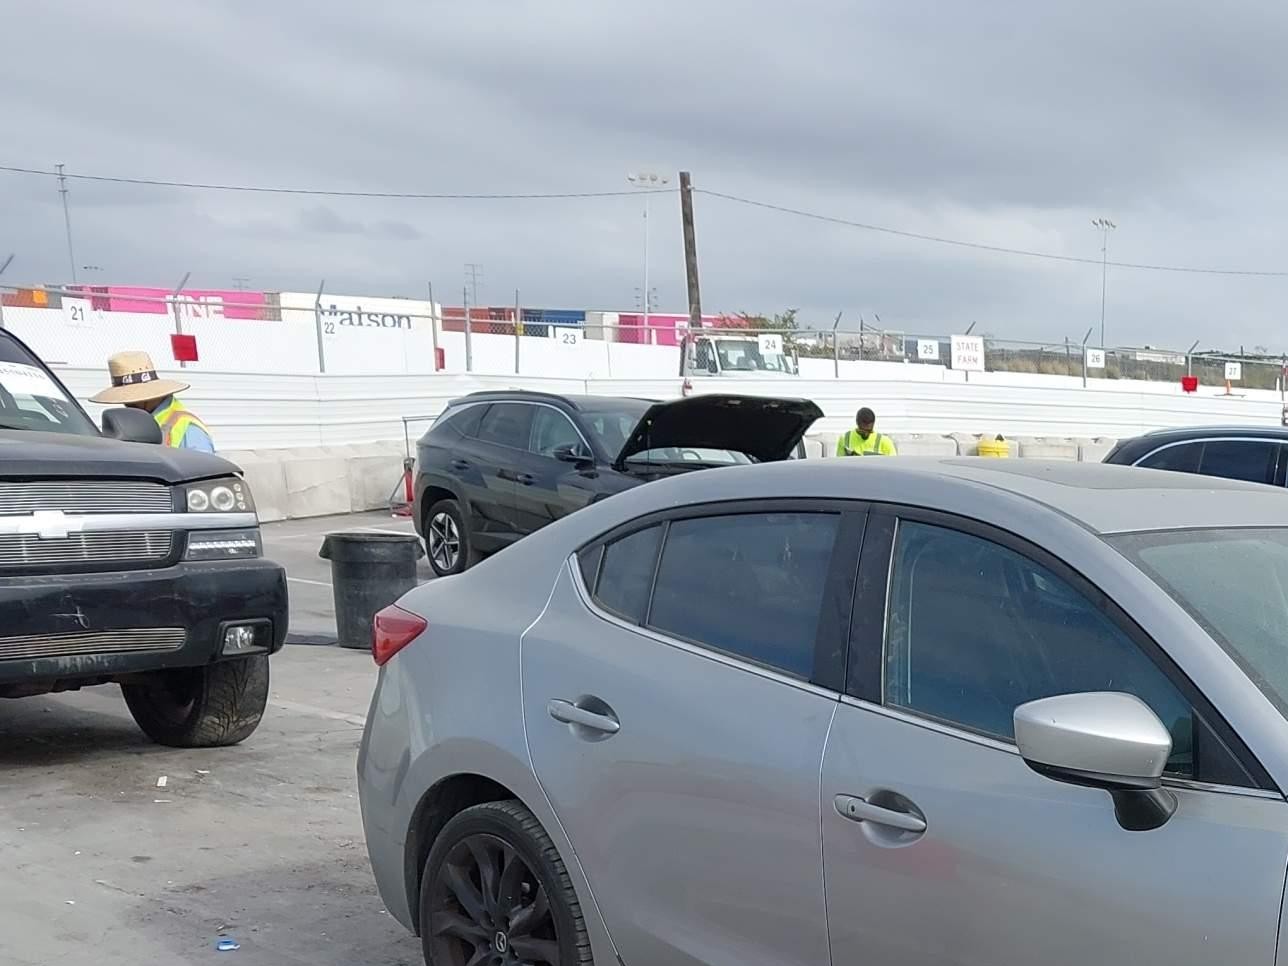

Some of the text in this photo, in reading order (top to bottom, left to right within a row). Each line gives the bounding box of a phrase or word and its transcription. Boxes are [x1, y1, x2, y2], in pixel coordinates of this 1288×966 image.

[71, 306, 84, 321] 21
[324, 321, 335, 334] 22
[562, 333, 577, 345] 23
[764, 339, 777, 350] 24
[923, 344, 934, 354] 25
[956, 342, 979, 352] STATE
